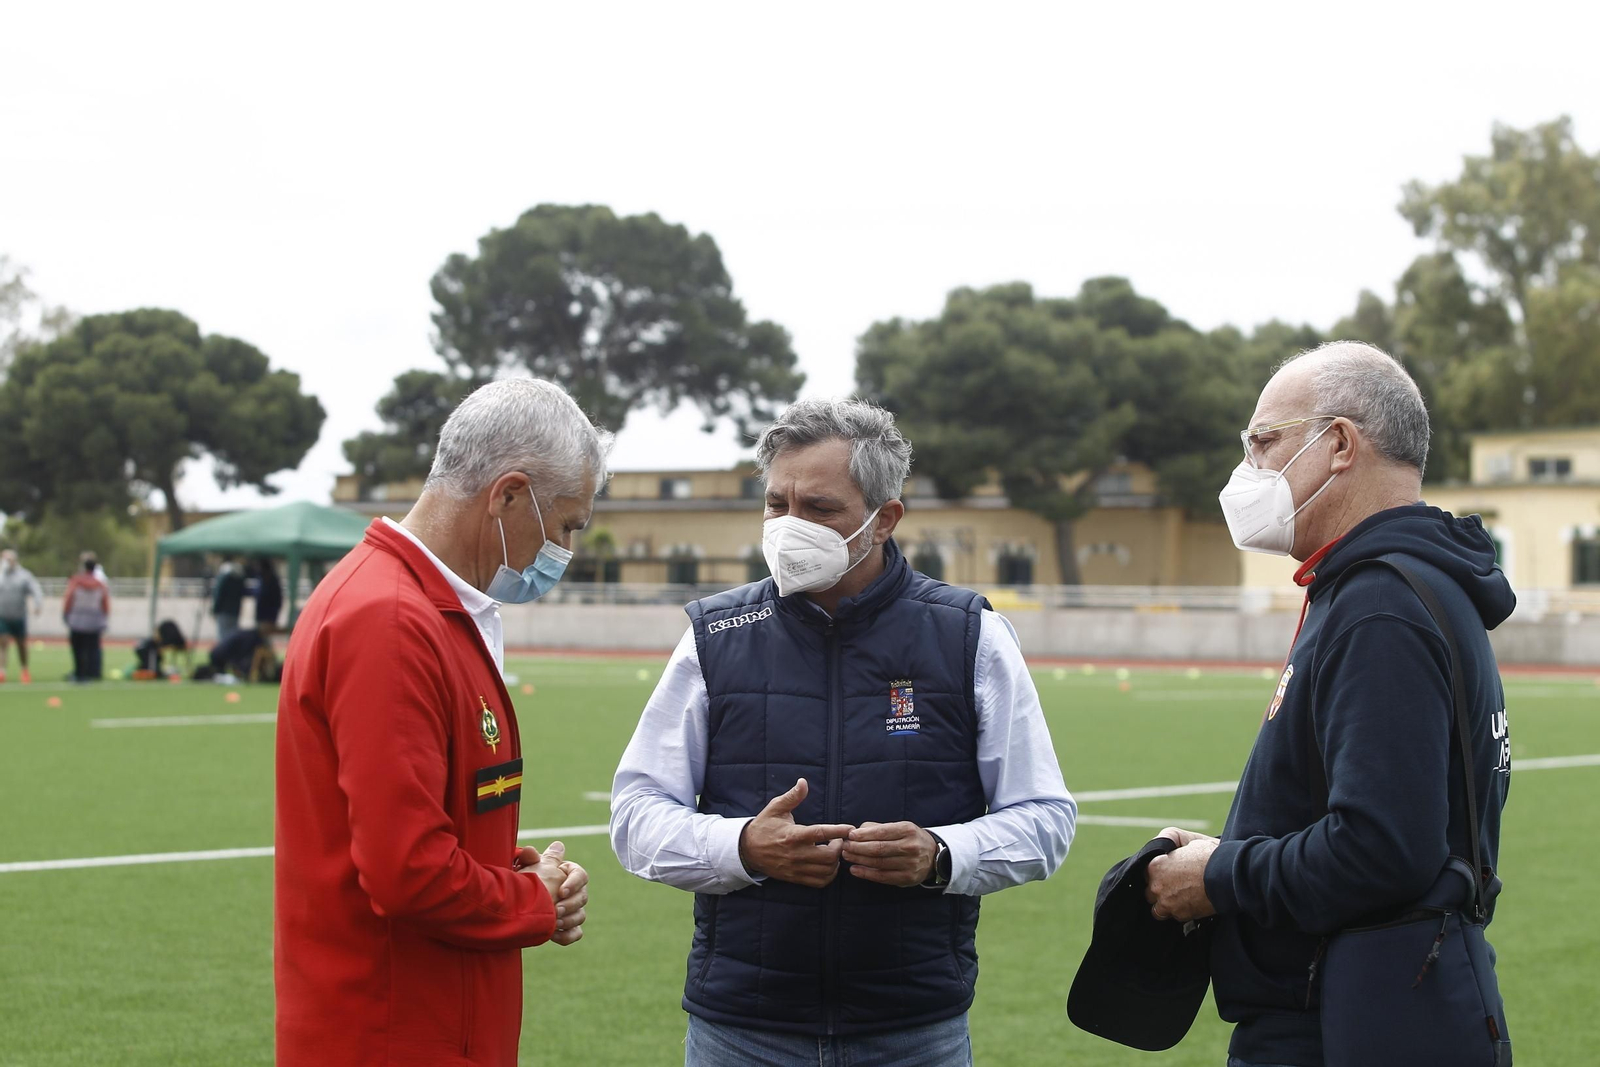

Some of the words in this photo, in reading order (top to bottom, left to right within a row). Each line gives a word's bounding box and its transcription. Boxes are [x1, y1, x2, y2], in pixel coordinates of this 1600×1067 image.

[708, 607, 772, 633] Kappa
[886, 715, 920, 725] DIPUTACIÓN
[896, 723, 921, 731] ALMERÍA
